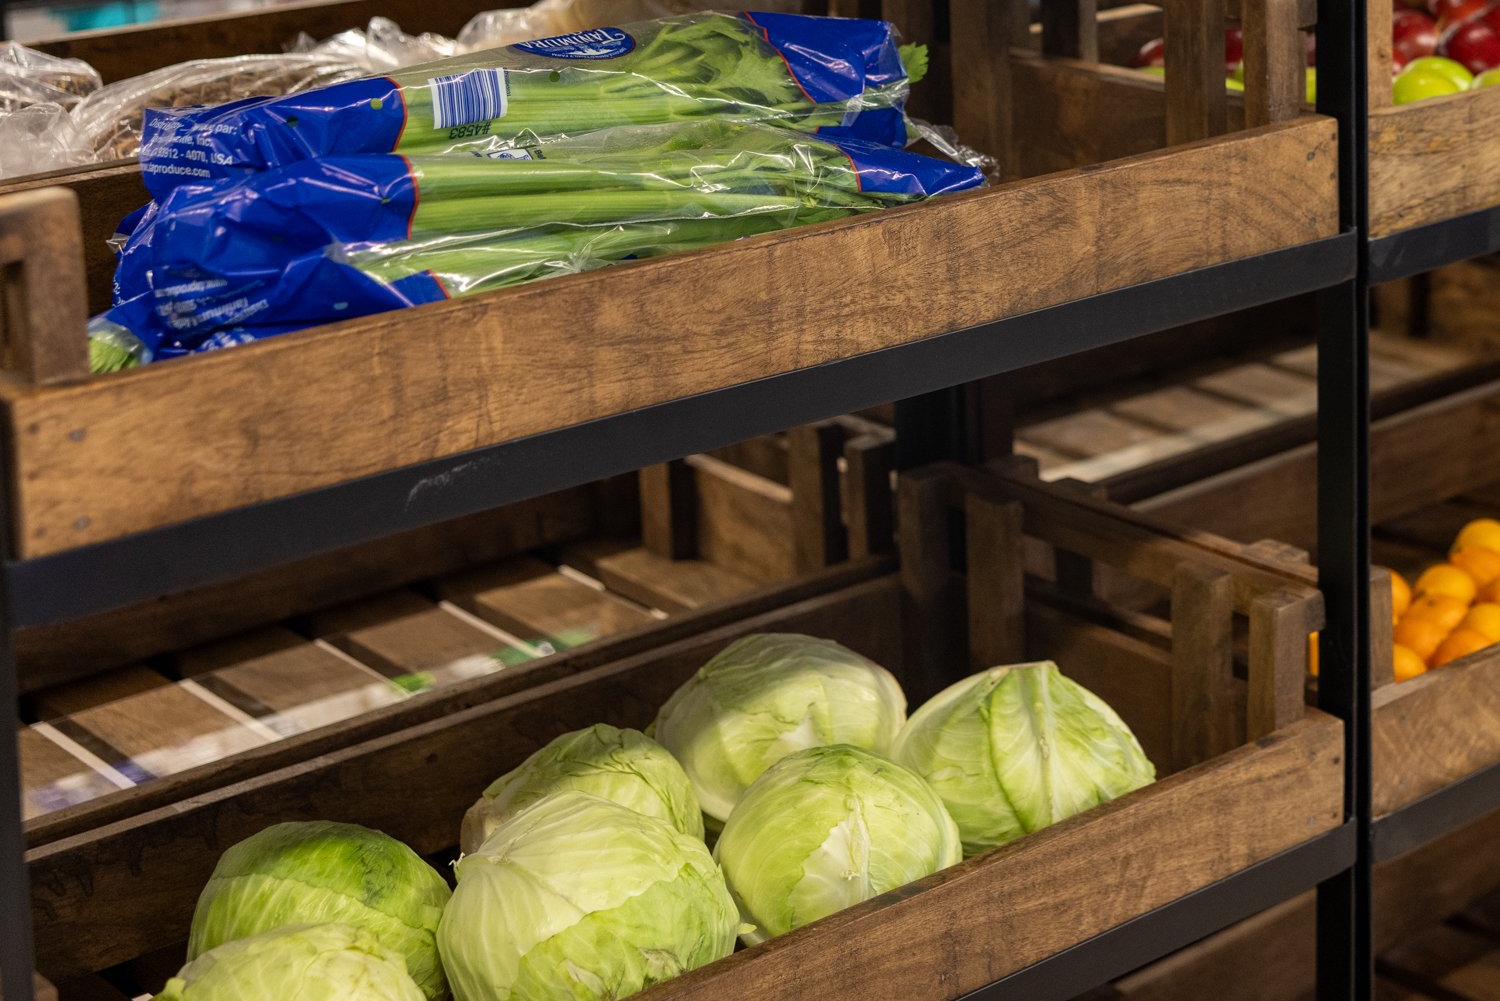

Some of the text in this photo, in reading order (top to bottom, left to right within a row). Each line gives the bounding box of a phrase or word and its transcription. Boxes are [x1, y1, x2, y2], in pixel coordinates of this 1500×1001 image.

[519, 29, 626, 49] TANIMURA
[214, 123, 238, 135] par:
[448, 121, 492, 139] #4583
[211, 153, 233, 165] USA
